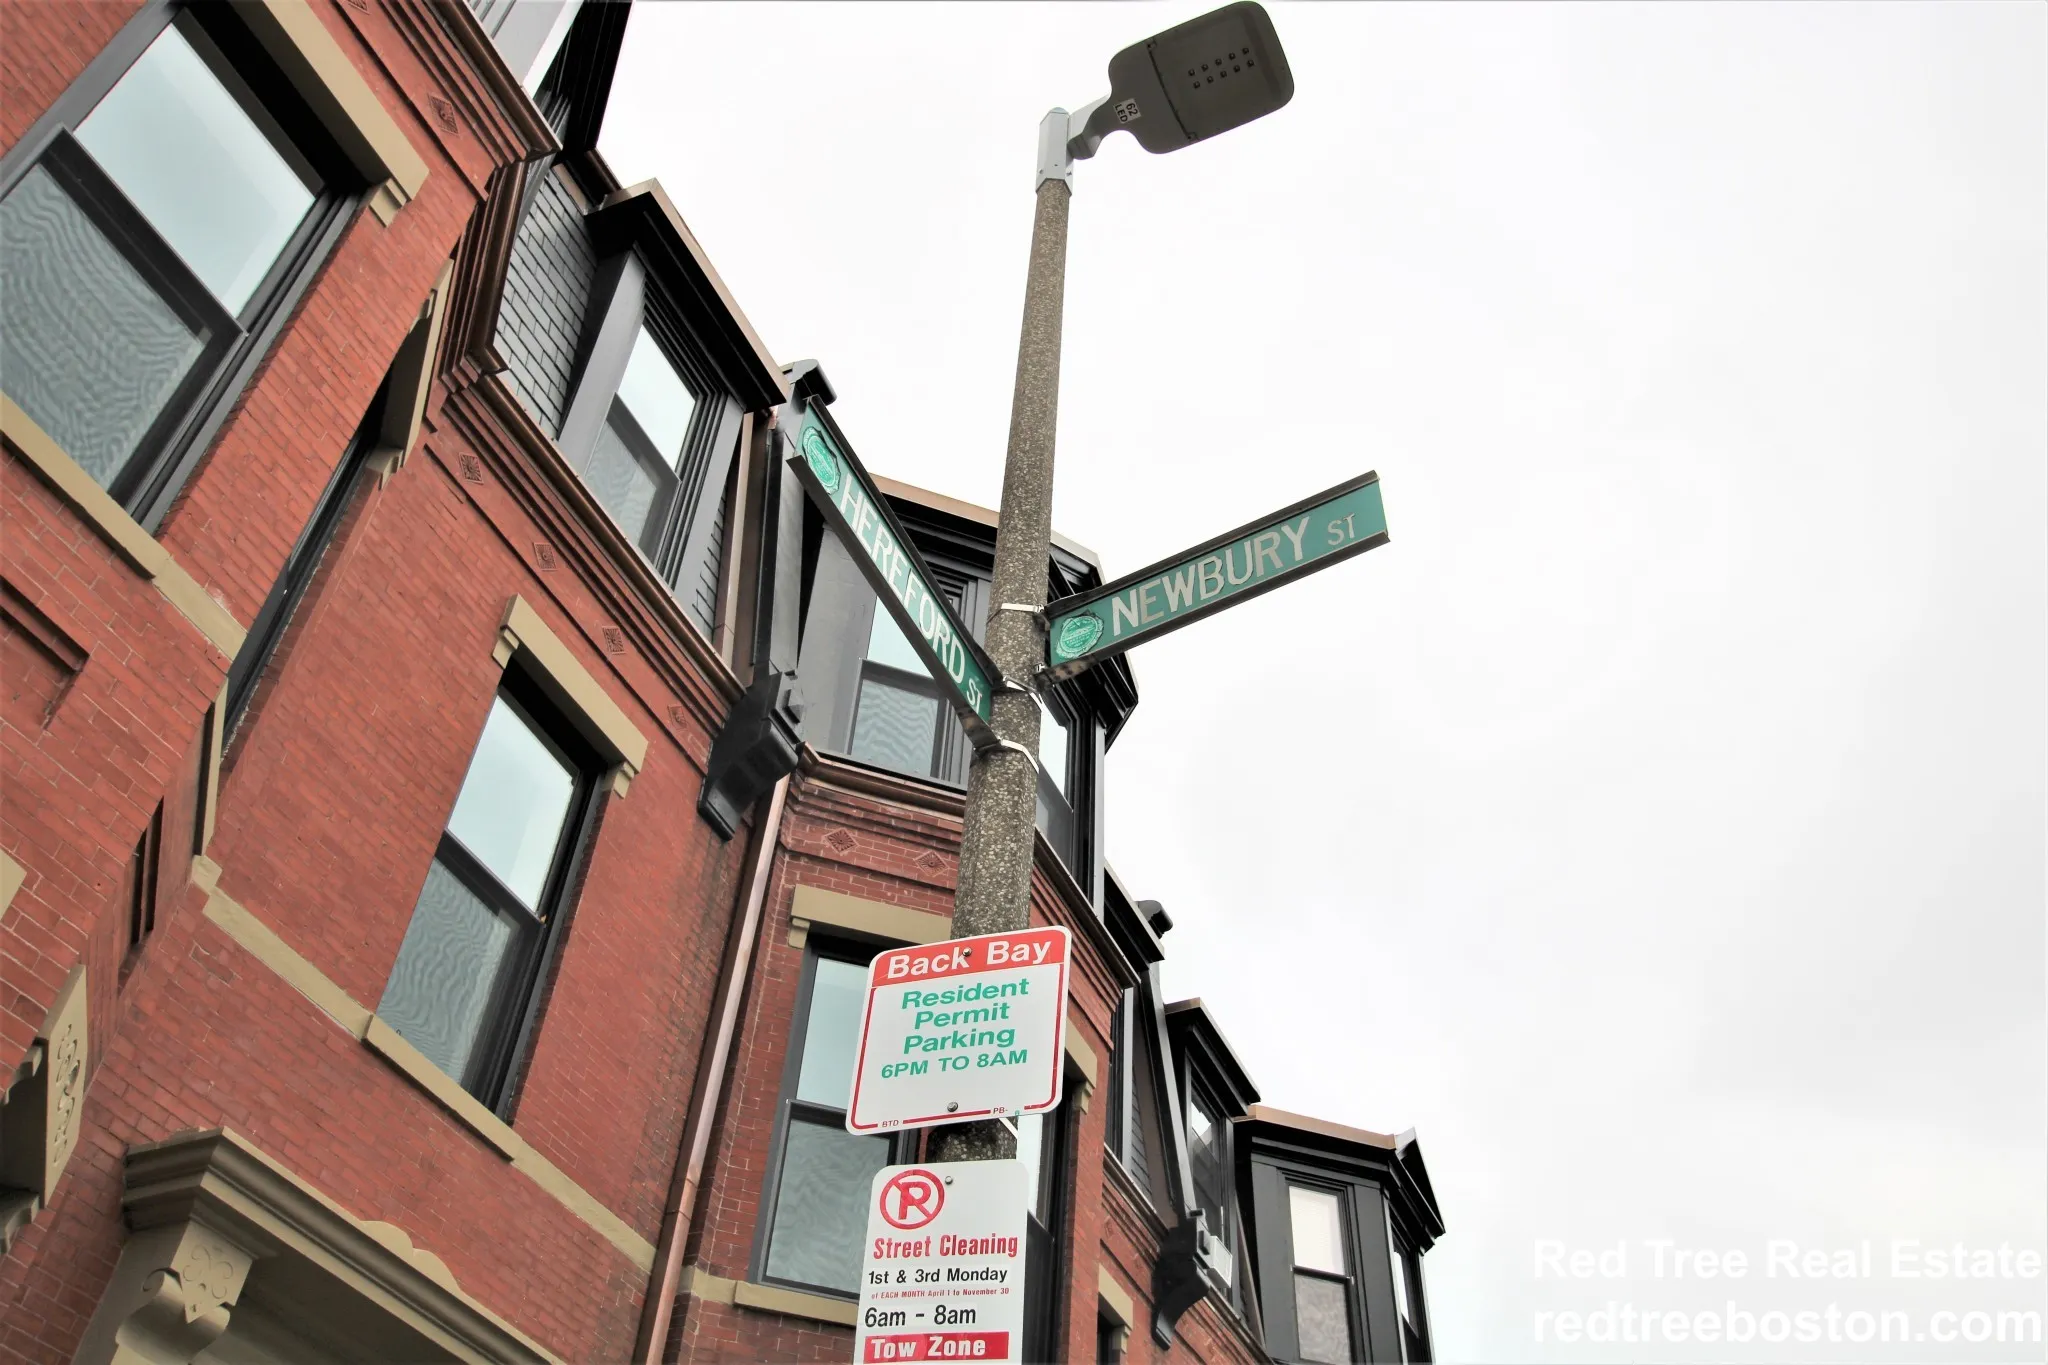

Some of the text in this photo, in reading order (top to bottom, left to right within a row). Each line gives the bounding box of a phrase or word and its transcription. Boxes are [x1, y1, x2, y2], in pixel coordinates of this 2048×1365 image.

[1115, 104, 1128, 122] LED
[1126, 103, 1138, 116] 62
[1111, 513, 1355, 636] NEWBURY ST
[840, 473, 983, 714] HEREFORD ST
[887, 941, 1051, 979] Back Bay
[901, 978, 1030, 1009] Resident
[914, 1002, 1010, 1030] Permit
[903, 1028, 1016, 1054] Parking
[881, 1049, 1028, 1079] 6PM TO 8AM
[873, 1233, 1018, 1259] Street Cleaning
[868, 1267, 1008, 1284] 1st & 3rd Monday
[881, 1291, 899, 1299] EACH
[901, 1290, 925, 1298] MONTH
[928, 1289, 945, 1298] April
[953, 1288, 960, 1296] to
[962, 1287, 997, 1296] November
[1000, 1287, 1010, 1295] 30
[864, 1307, 906, 1327] 6am
[934, 1305, 976, 1325] 8am
[871, 1336, 986, 1359] Tow Zone
